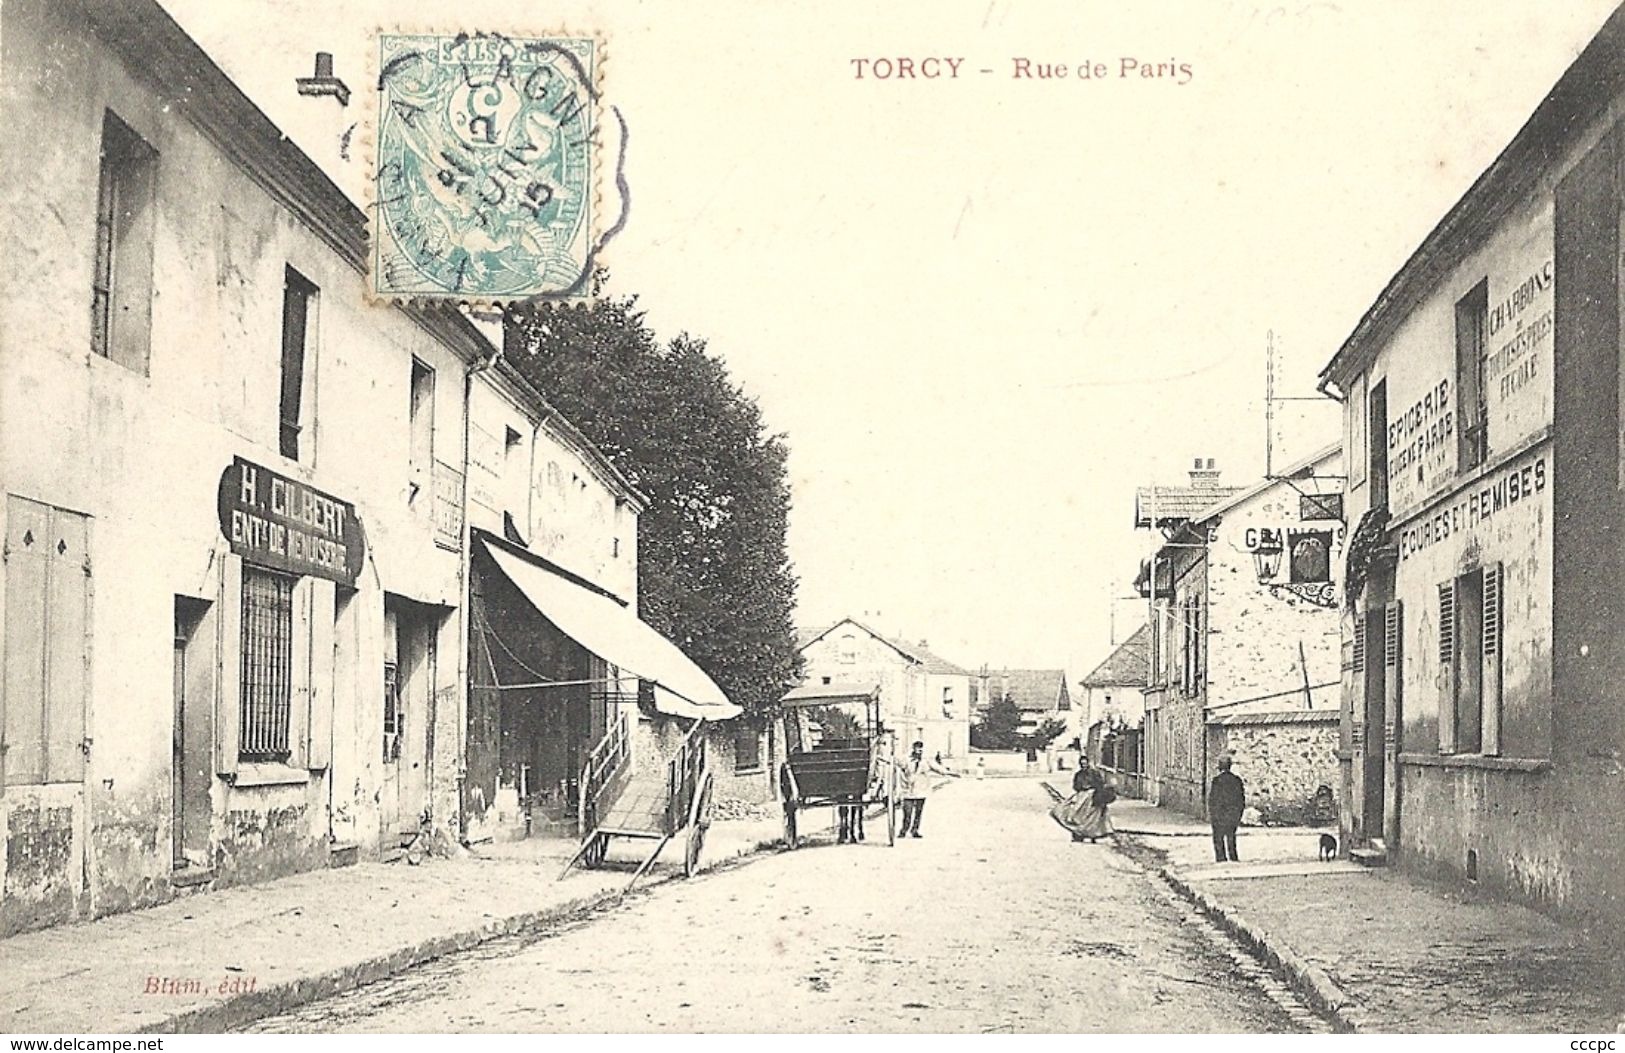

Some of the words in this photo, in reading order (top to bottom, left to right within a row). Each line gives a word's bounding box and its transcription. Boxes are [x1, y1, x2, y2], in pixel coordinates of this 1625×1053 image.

[1389, 378, 1449, 449] EPICERIE
[1469, 458, 1546, 530] REMISES
[269, 521, 285, 556] DE
